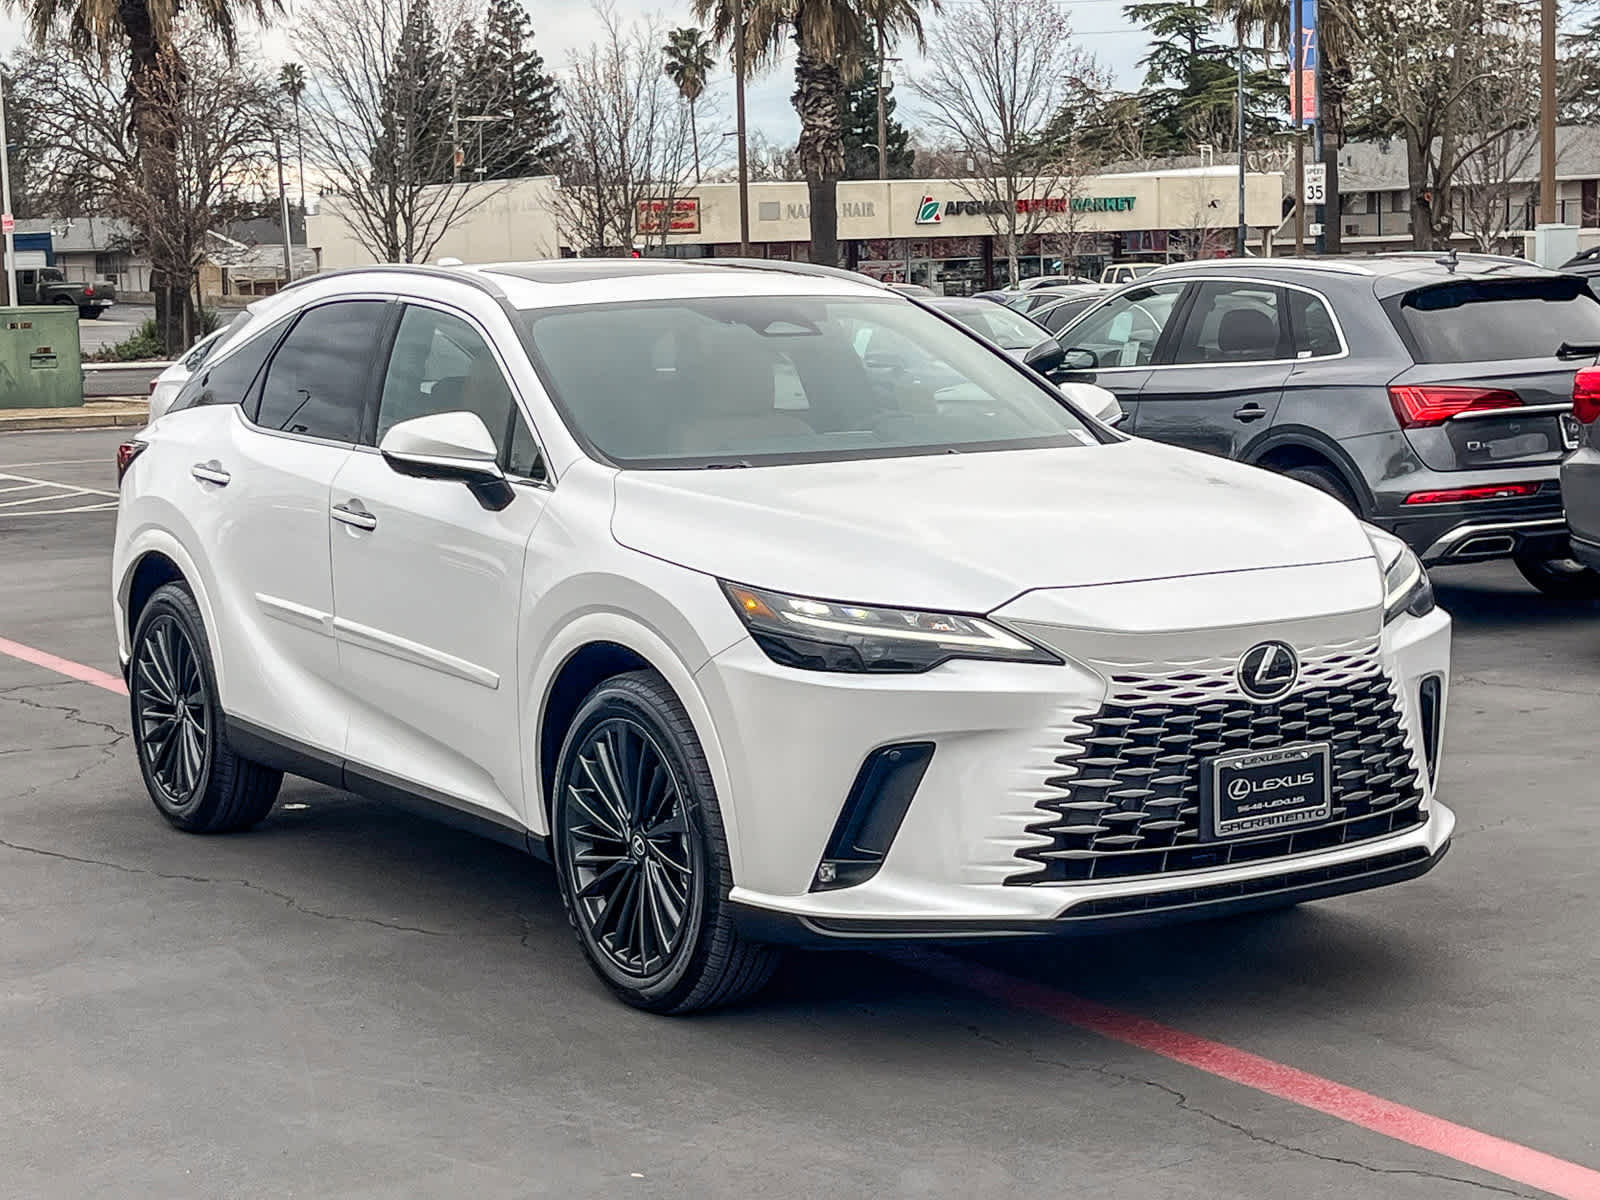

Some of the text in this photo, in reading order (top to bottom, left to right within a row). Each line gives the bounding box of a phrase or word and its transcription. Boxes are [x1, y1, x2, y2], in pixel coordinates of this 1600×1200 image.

[1307, 185, 1323, 200] 35
[842, 202, 876, 218] HAIR
[944, 200, 1015, 216] AFGHA
[1069, 196, 1136, 213] MARKET
[1243, 753, 1283, 766] LEXUS
[1252, 772, 1315, 793] LEXUS
[1220, 808, 1327, 834] SACRAMENTO
